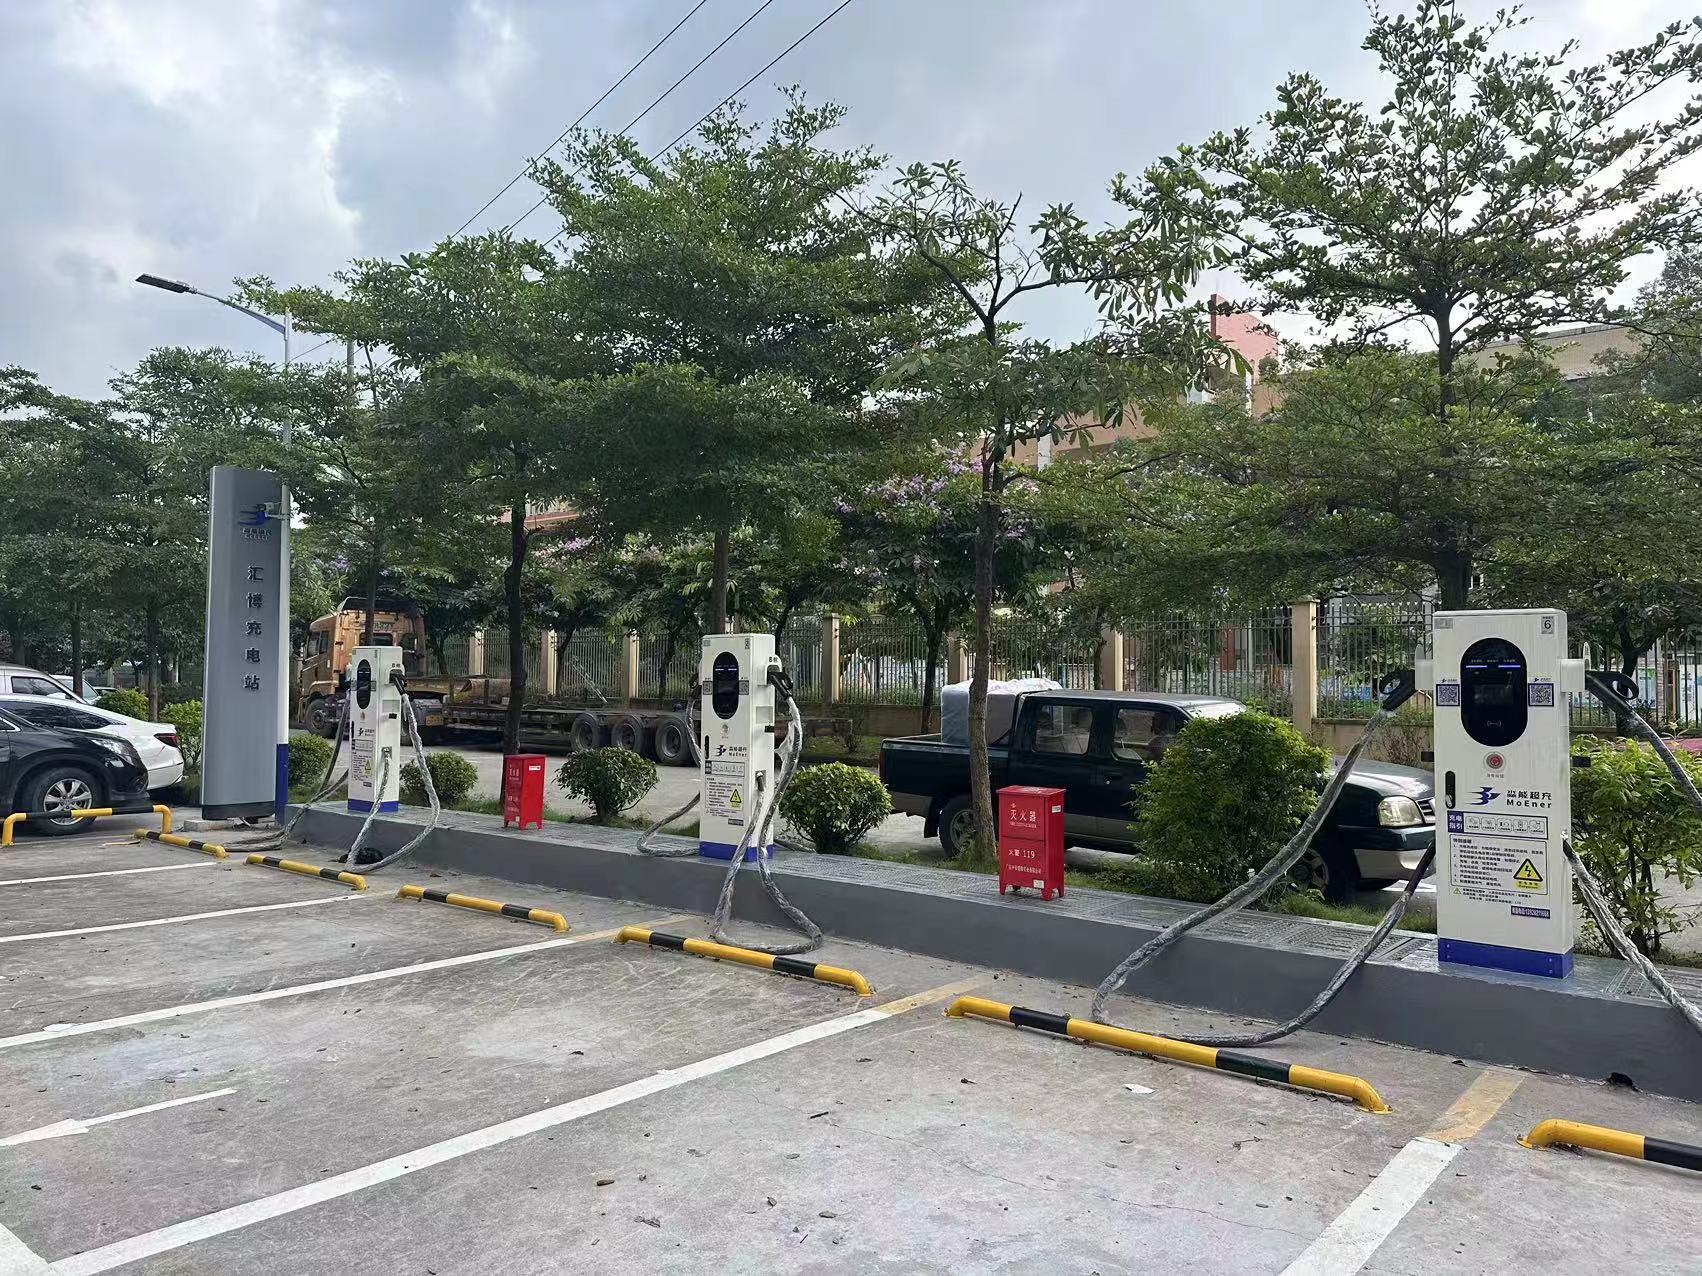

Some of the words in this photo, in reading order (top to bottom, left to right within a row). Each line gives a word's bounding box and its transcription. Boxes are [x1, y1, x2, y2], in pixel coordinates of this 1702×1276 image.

[243, 565, 264, 691] 汇博充电站
[1544, 620, 1551, 629] 6
[1506, 799, 1552, 808] MoEner
[1010, 810, 1036, 822] 灭火器
